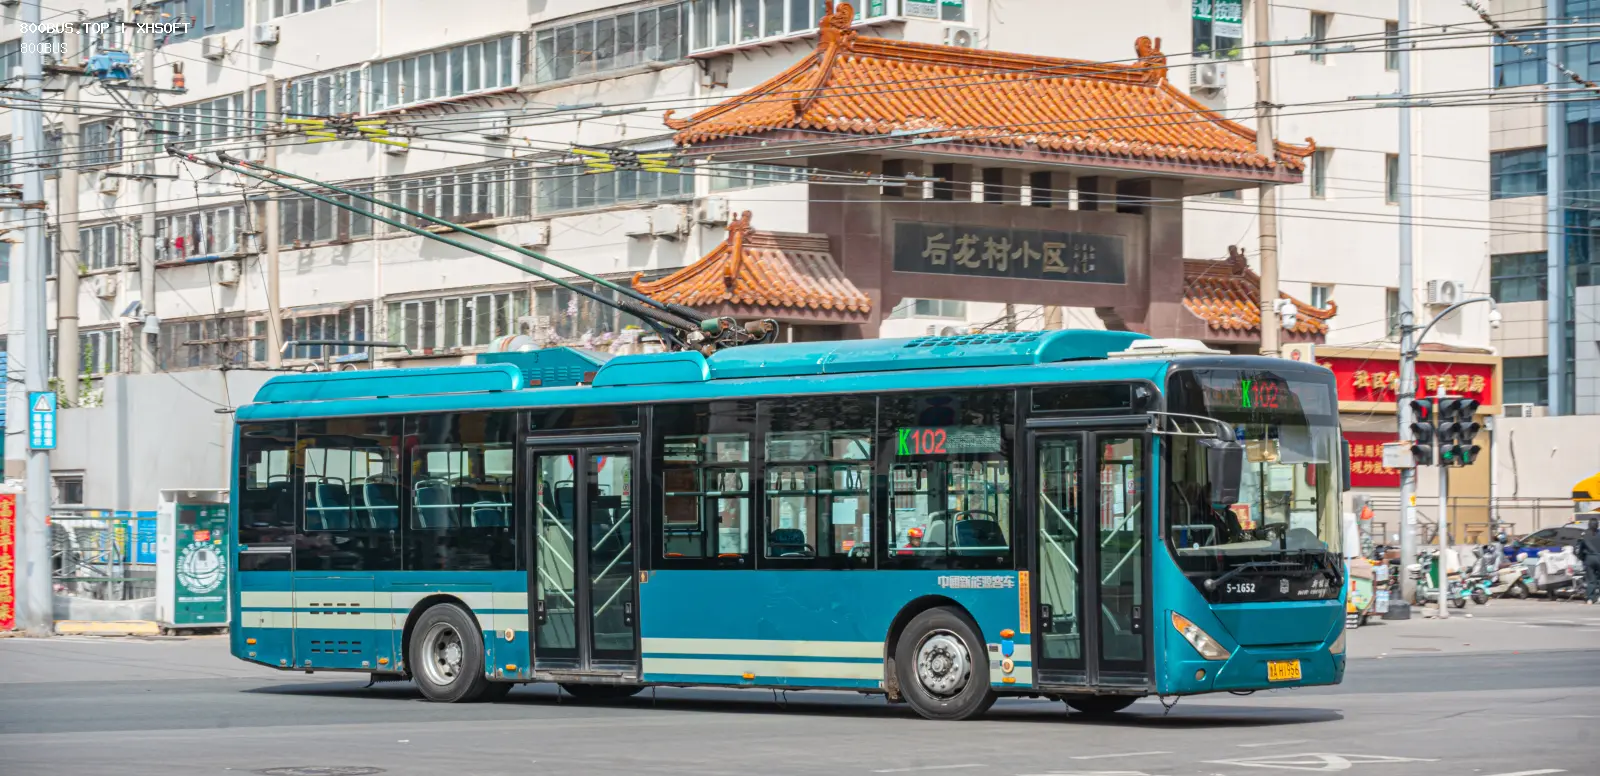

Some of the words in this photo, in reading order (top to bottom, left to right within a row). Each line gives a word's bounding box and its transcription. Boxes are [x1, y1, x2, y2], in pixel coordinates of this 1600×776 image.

[922, 233, 1069, 272] 后龙村小区
[1242, 380, 1278, 407] K102
[898, 428, 947, 454] K102
